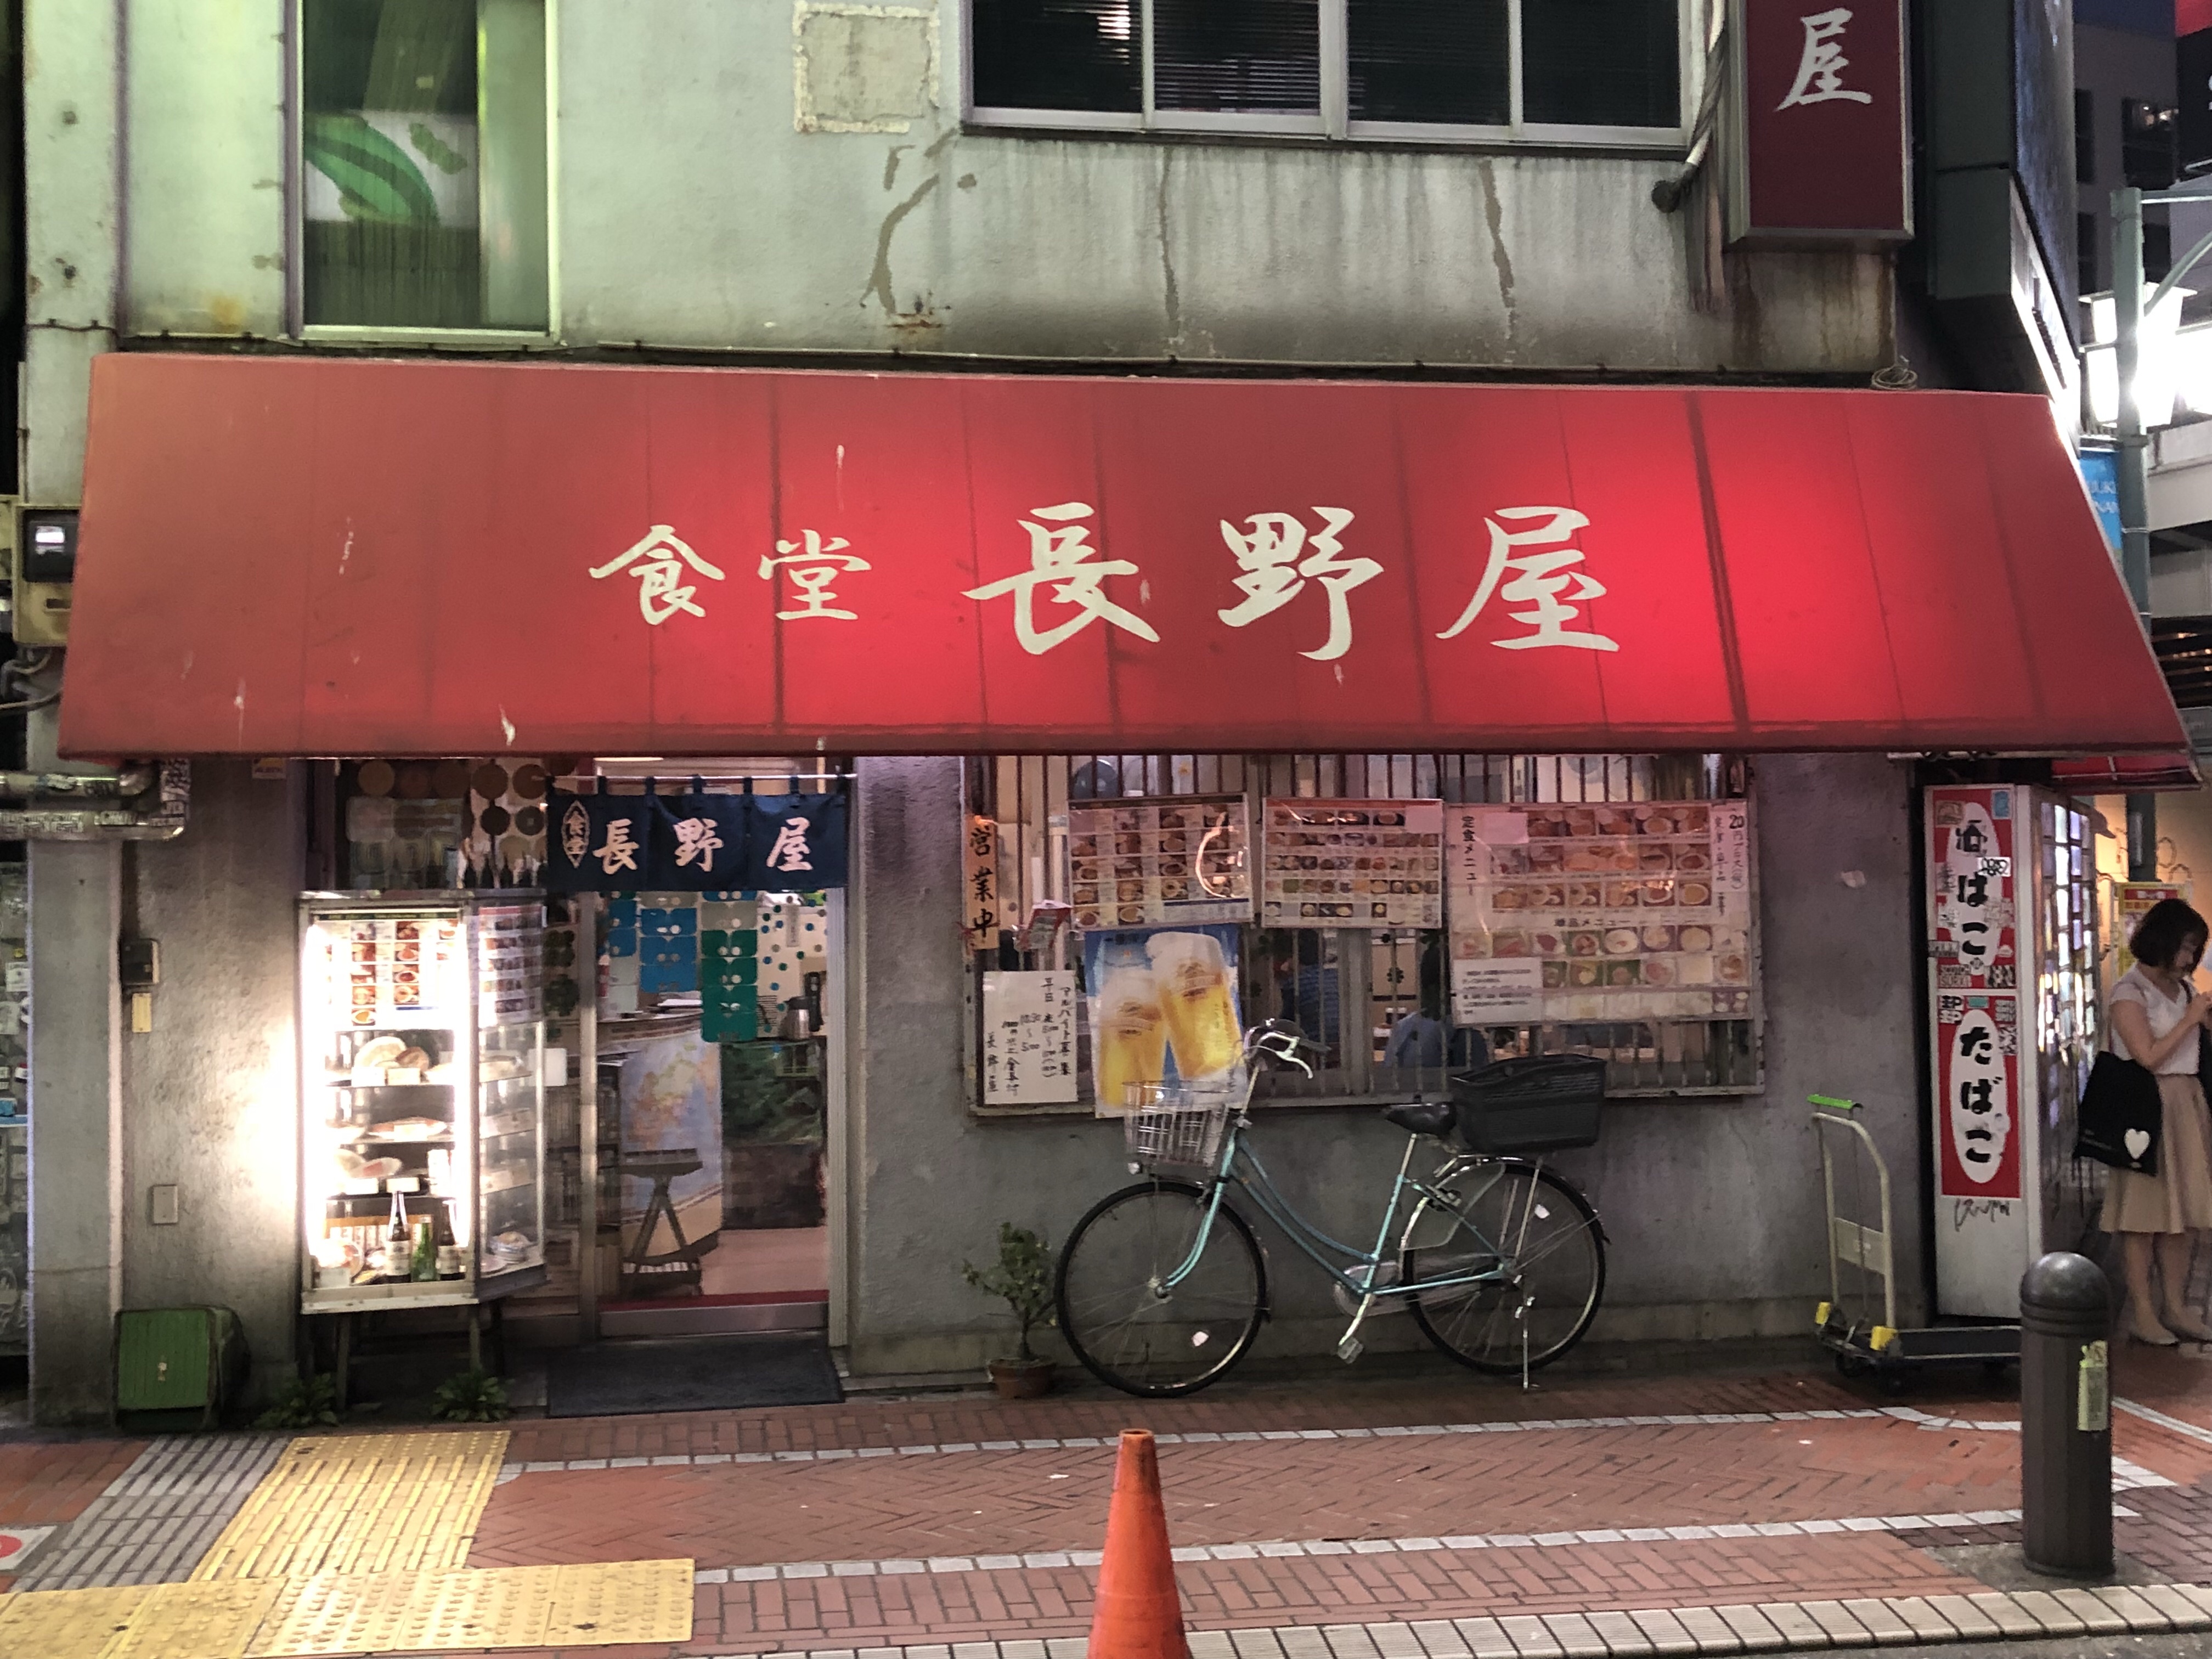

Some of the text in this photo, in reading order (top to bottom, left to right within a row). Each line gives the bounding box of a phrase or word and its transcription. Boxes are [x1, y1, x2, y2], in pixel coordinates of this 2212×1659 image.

[1774, 7, 1873, 111] 屋
[589, 501, 1620, 662] 食堂 長野屋
[592, 816, 814, 875] 長野屋
[969, 825, 994, 939] 営業中
[1959, 1026, 2003, 1164] たばこ
